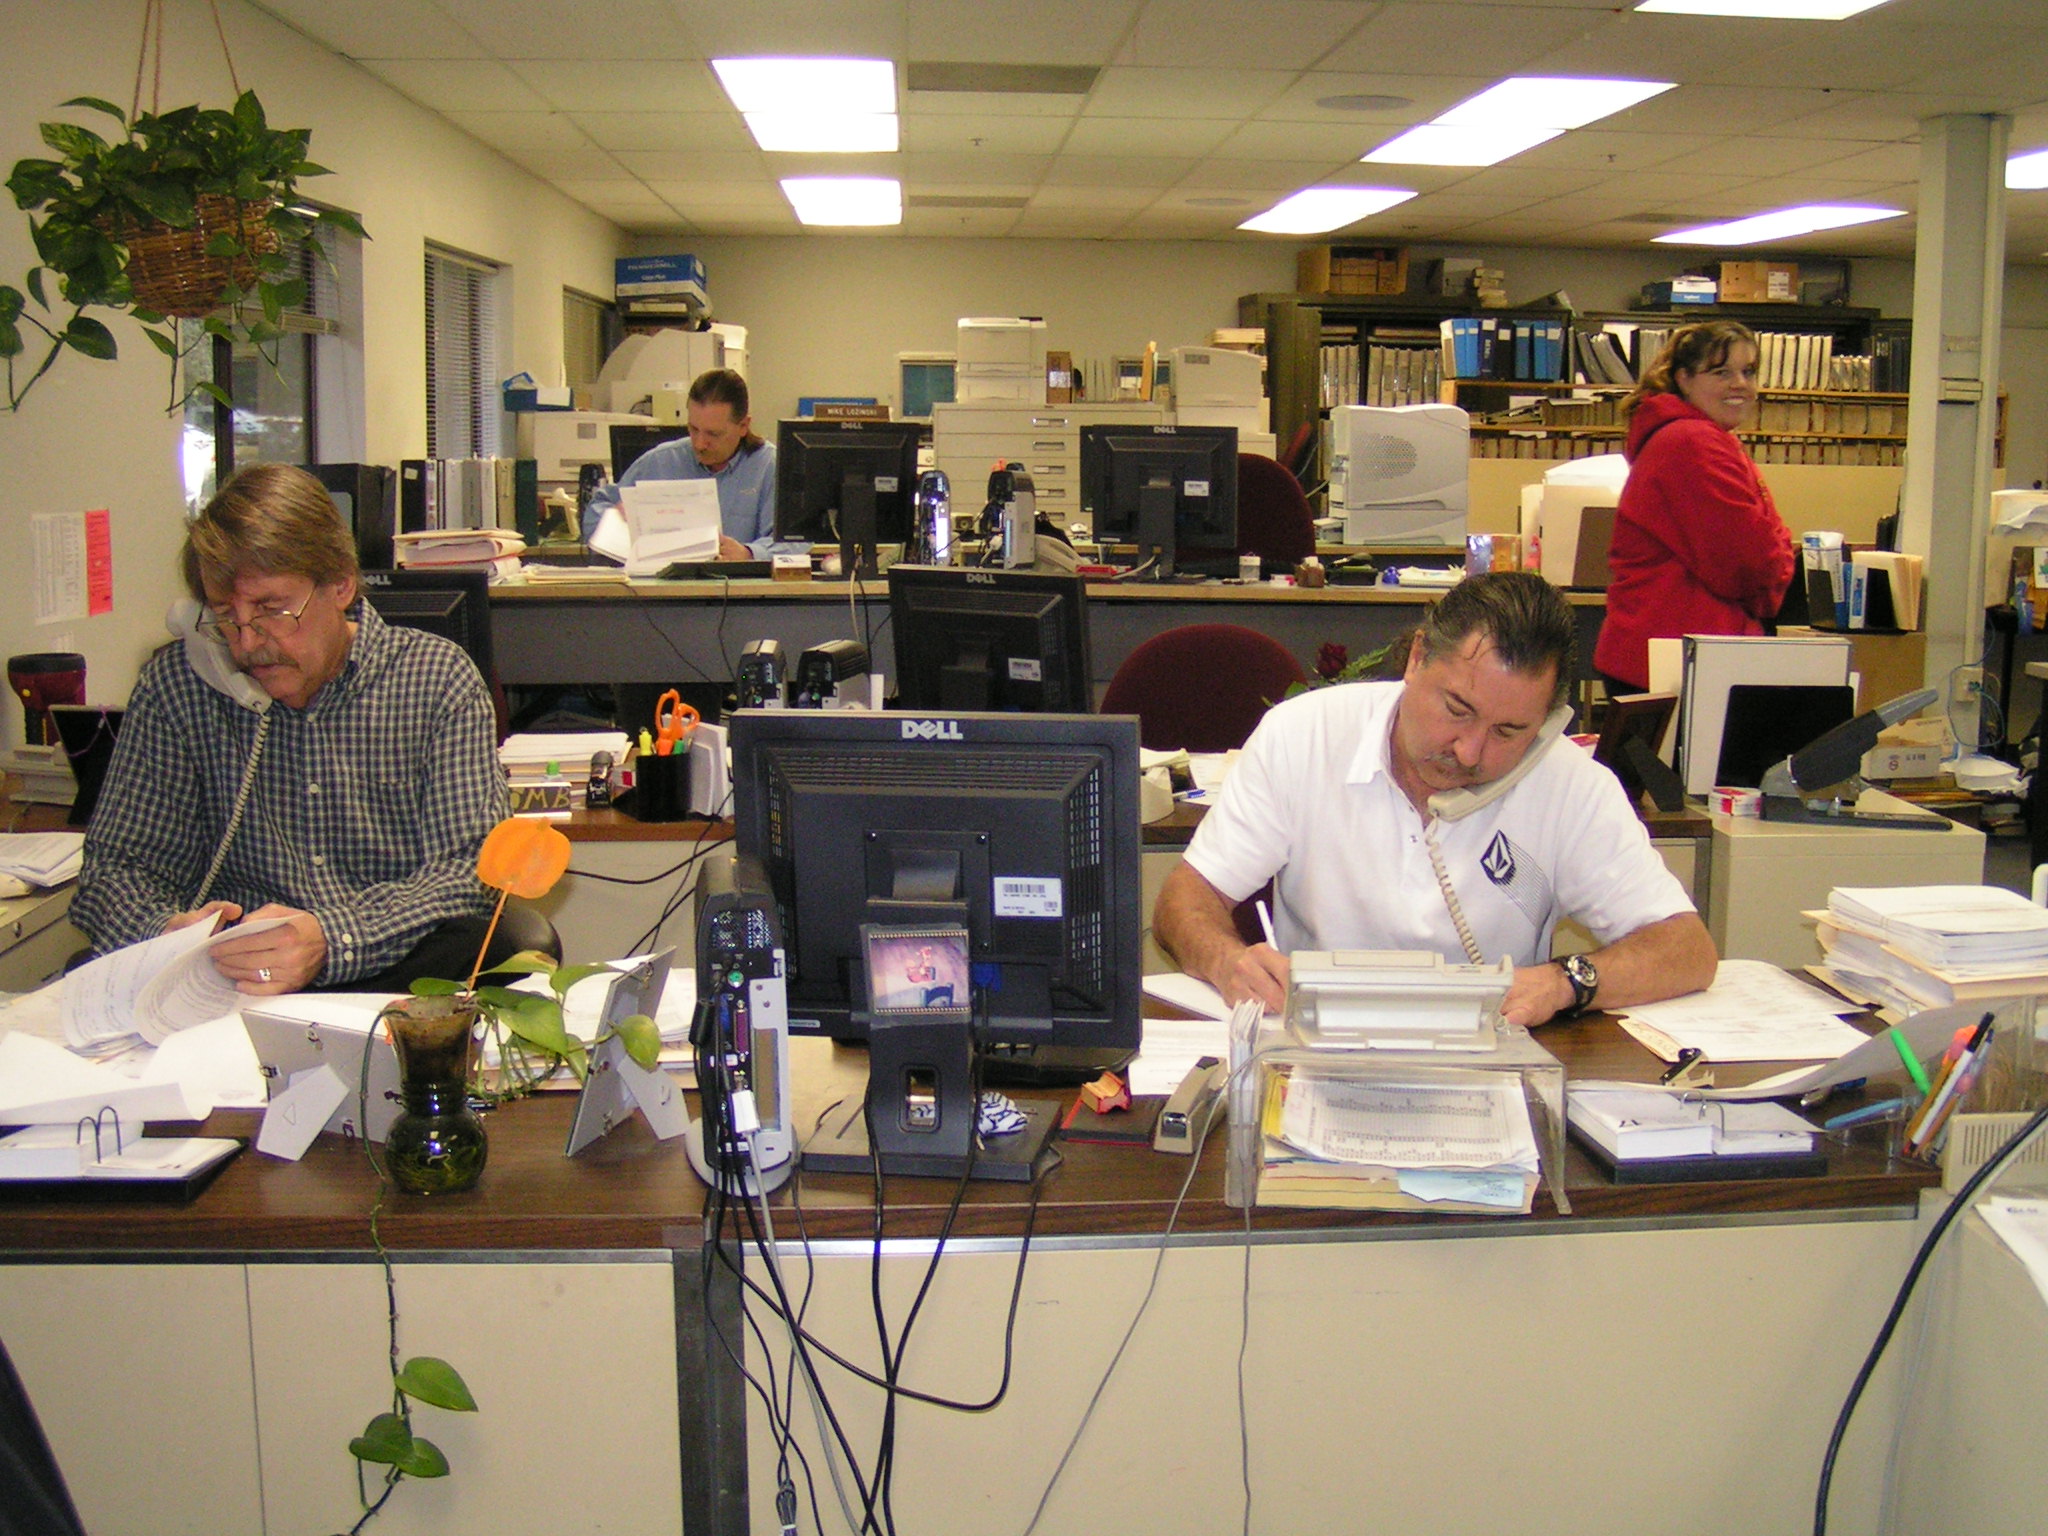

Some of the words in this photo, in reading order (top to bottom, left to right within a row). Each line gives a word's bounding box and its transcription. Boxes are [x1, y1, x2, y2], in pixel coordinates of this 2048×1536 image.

[827, 408, 844, 416] MIKE
[841, 422, 864, 430] DELL
[1153, 426, 1177, 434] DELL
[362, 575, 392, 586] ELL
[966, 573, 997, 584] DELL
[901, 719, 964, 739] DELL
